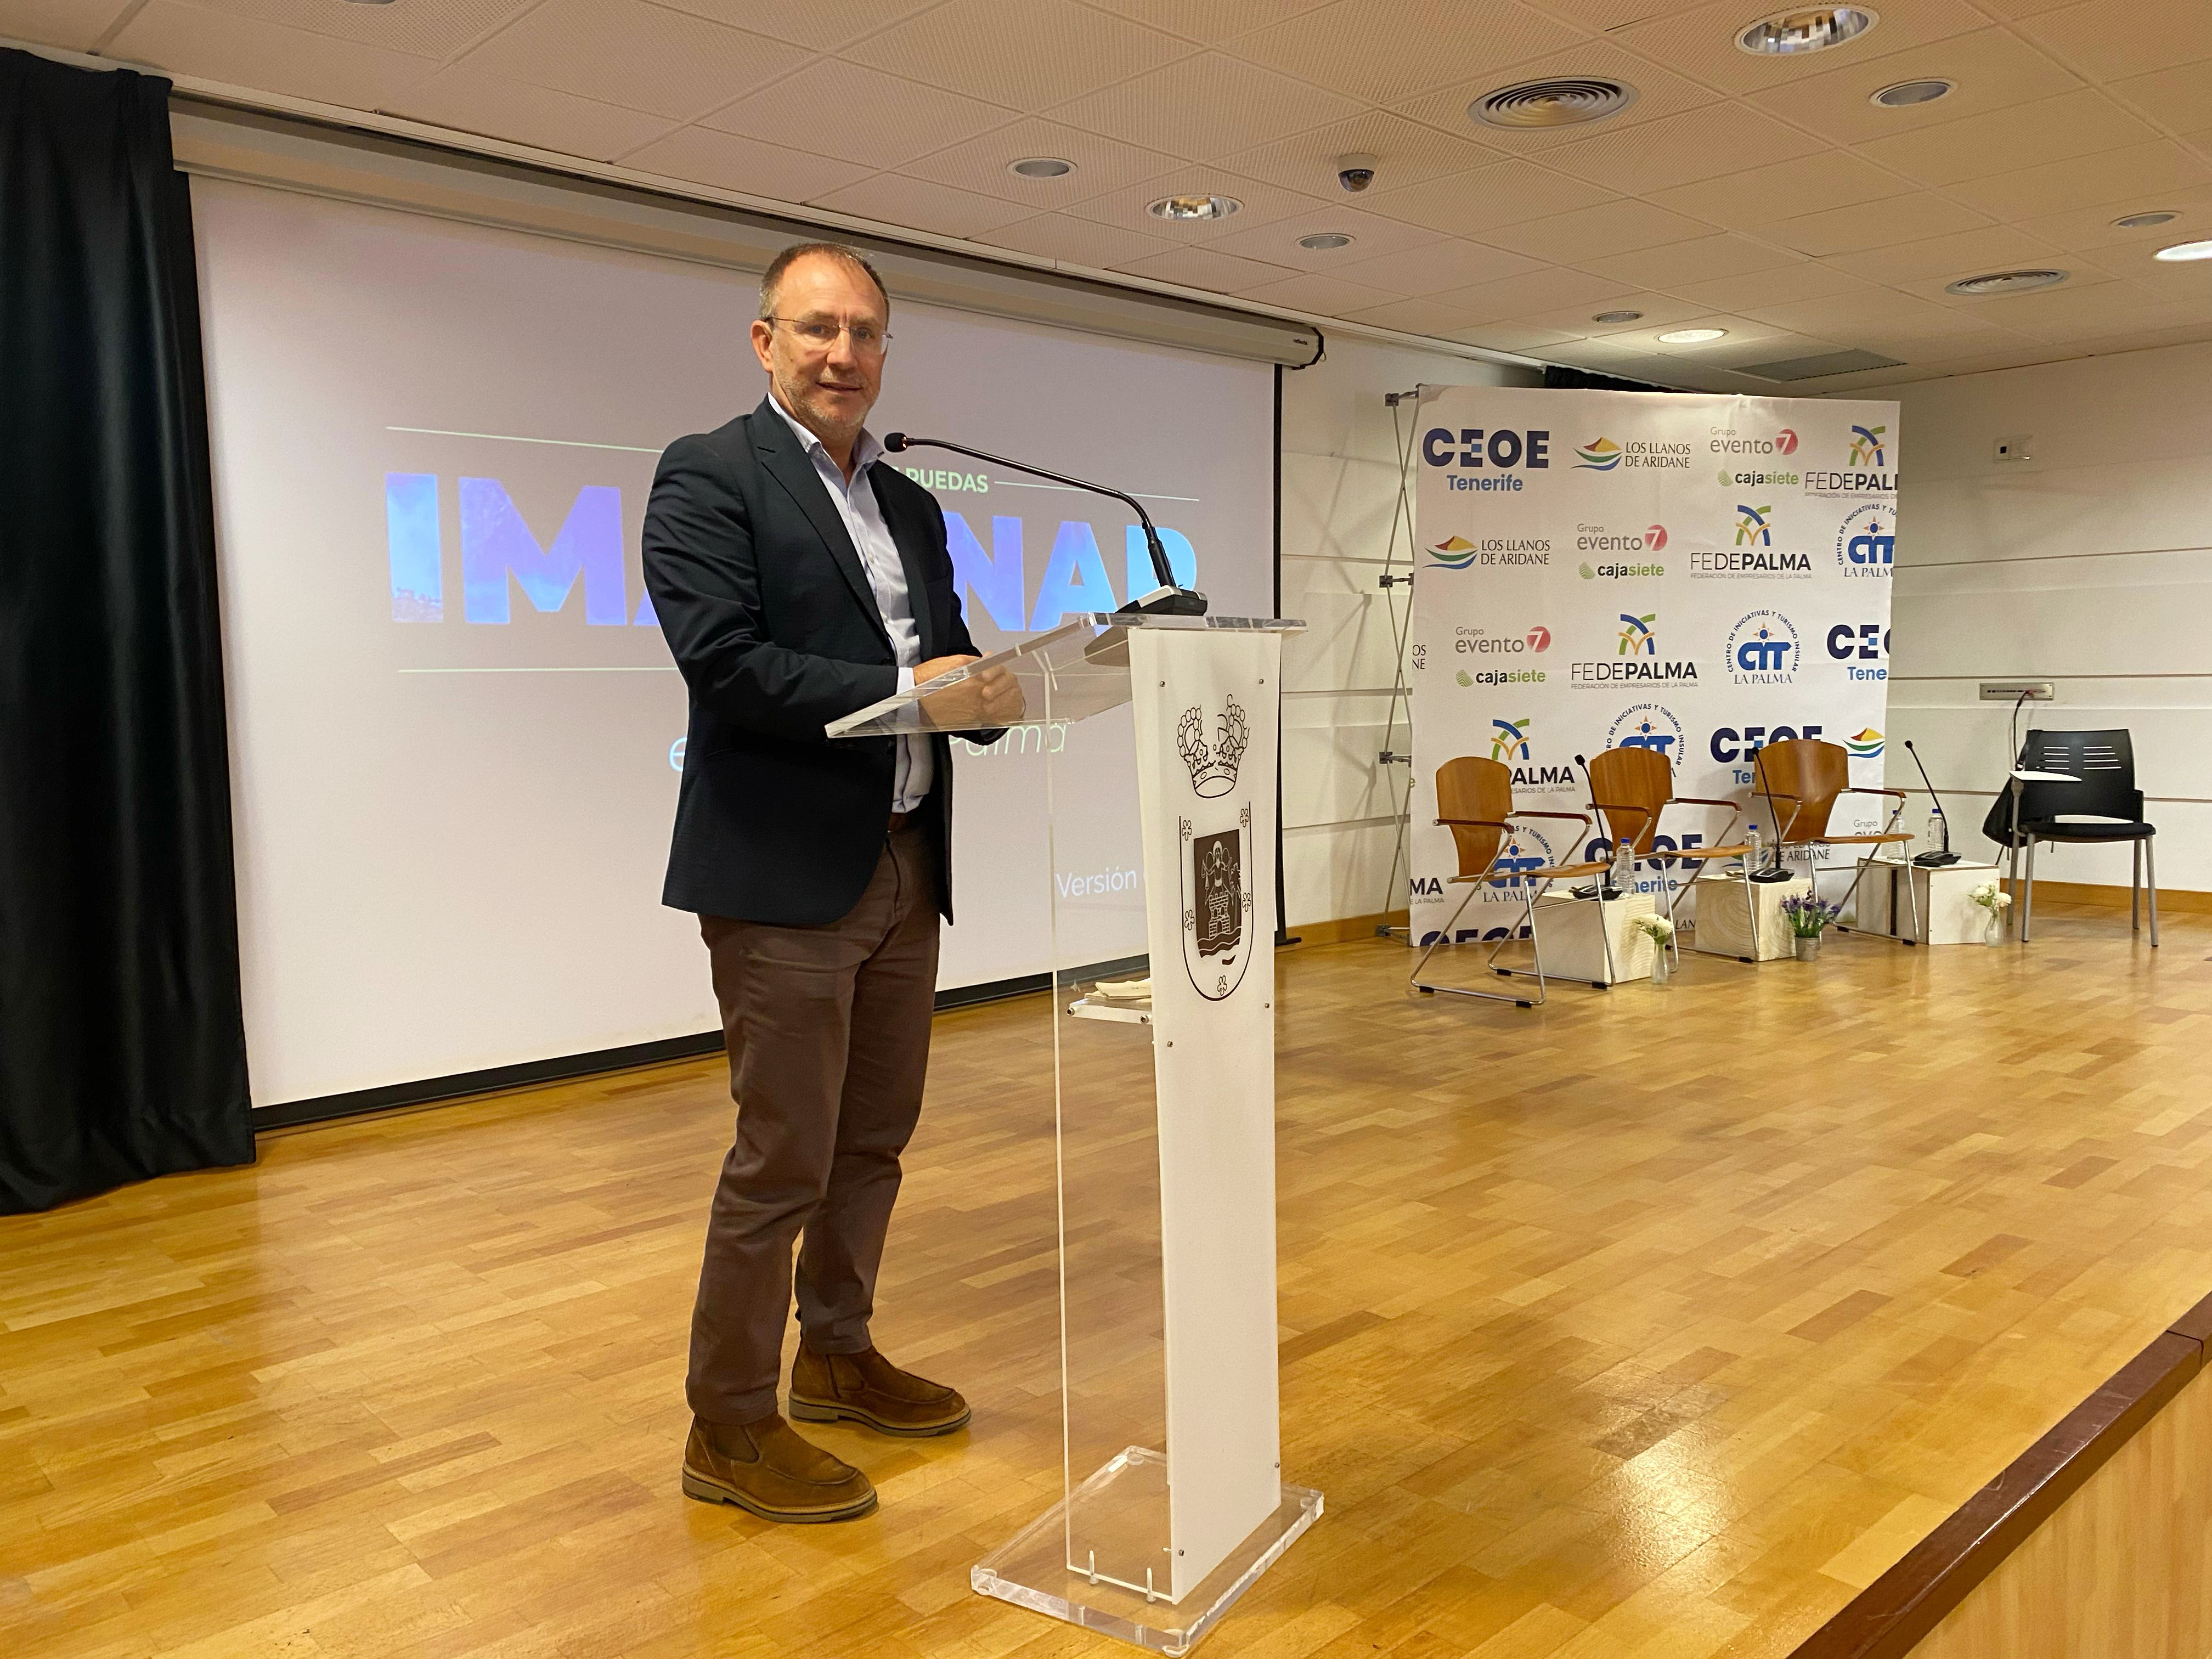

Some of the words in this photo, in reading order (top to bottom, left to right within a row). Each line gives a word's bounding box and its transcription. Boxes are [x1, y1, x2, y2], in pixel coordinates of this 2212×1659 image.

[1711, 426, 1736, 437] Grupo
[1423, 428, 1549, 468] CEOE
[1626, 442, 1646, 453] LOS
[1650, 443, 1690, 454] LLANOS
[1626, 456, 1639, 467] DE
[1642, 456, 1690, 468] ARIDANE
[906, 468, 989, 494] PUEDAS
[1447, 474, 1523, 491] Tenerife
[1735, 471, 1799, 487] cajasiete
[1839, 525, 1846, 534] DE
[1844, 504, 1880, 524] INICIATIVAS
[1577, 523, 1604, 534] Grupo
[1482, 539, 1503, 551] LOS
[1507, 540, 1550, 551] LLANOS
[1481, 554, 1496, 565] DE
[1499, 554, 1549, 565] ARIDANE
[1691, 552, 1811, 571] FEDEPALMA
[1598, 563, 1664, 579] cajasiete
[1844, 567, 1857, 577] LA
[1456, 627, 1484, 637] Grupo
[1729, 632, 1736, 641] DE
[1734, 610, 1769, 631] INICIATIVAS
[1778, 614, 1797, 639] TURISMO
[1792, 641, 1800, 672] INSULAR
[1827, 624, 1891, 659] CE
[1476, 669, 1545, 686] cajasiete
[1572, 662, 1697, 680] FEDEPALMA
[1734, 674, 1748, 684] LA
[1752, 674, 1792, 684] PALMA
[1847, 667, 1887, 680] Tene
[1609, 726, 1616, 736] DE
[1615, 703, 1651, 726] INICIATIVAS
[1660, 707, 1681, 732] TURISMO
[1675, 735, 1684, 766] INSULAR
[1509, 766, 1575, 785] ALMA
[1854, 820, 1877, 829] Grupo
[1529, 829, 1551, 854] TURISMO
[1787, 849, 1830, 861] ARIDANE
[1057, 866, 1137, 899] Versión
[1483, 891, 1499, 902] LA
